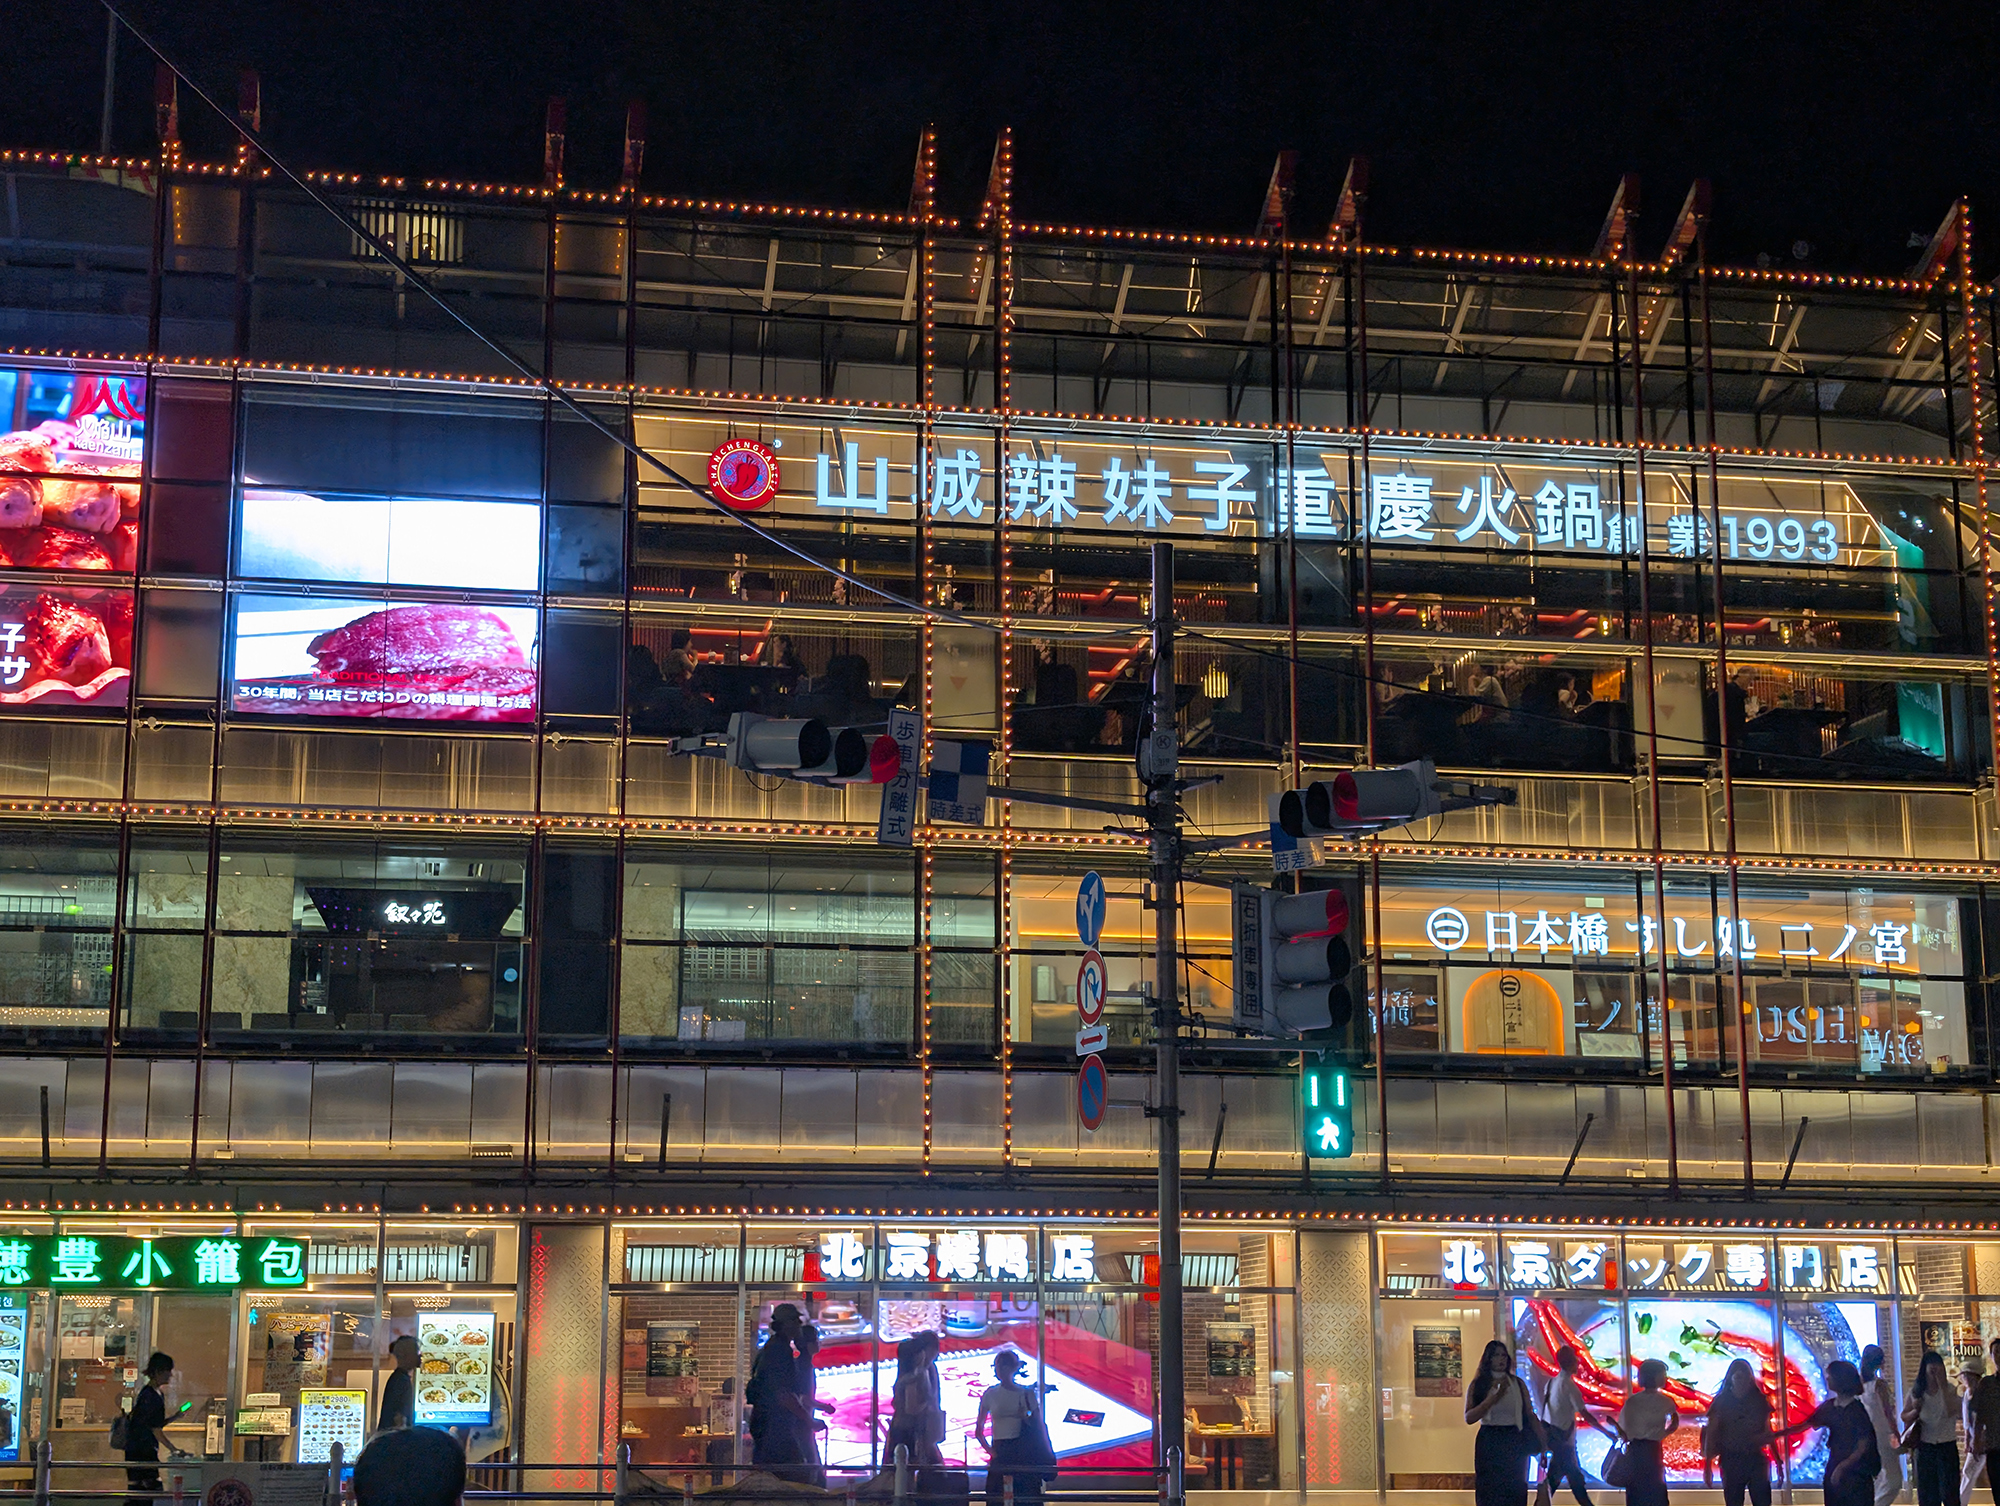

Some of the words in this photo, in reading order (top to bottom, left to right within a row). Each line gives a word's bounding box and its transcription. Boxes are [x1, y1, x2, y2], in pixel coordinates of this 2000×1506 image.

[74, 437, 132, 458] kaenzan
[1721, 515, 1839, 561] 1993
[311, 669, 410, 683] TRADITIONAL
[886, 720, 916, 838] 歩車分離式
[930, 800, 983, 825] 時差式
[1485, 909, 1609, 956] 日本橋
[1778, 920, 1910, 965] 二ノ宮
[1443, 1241, 1879, 1288] 北京ダック専門店
